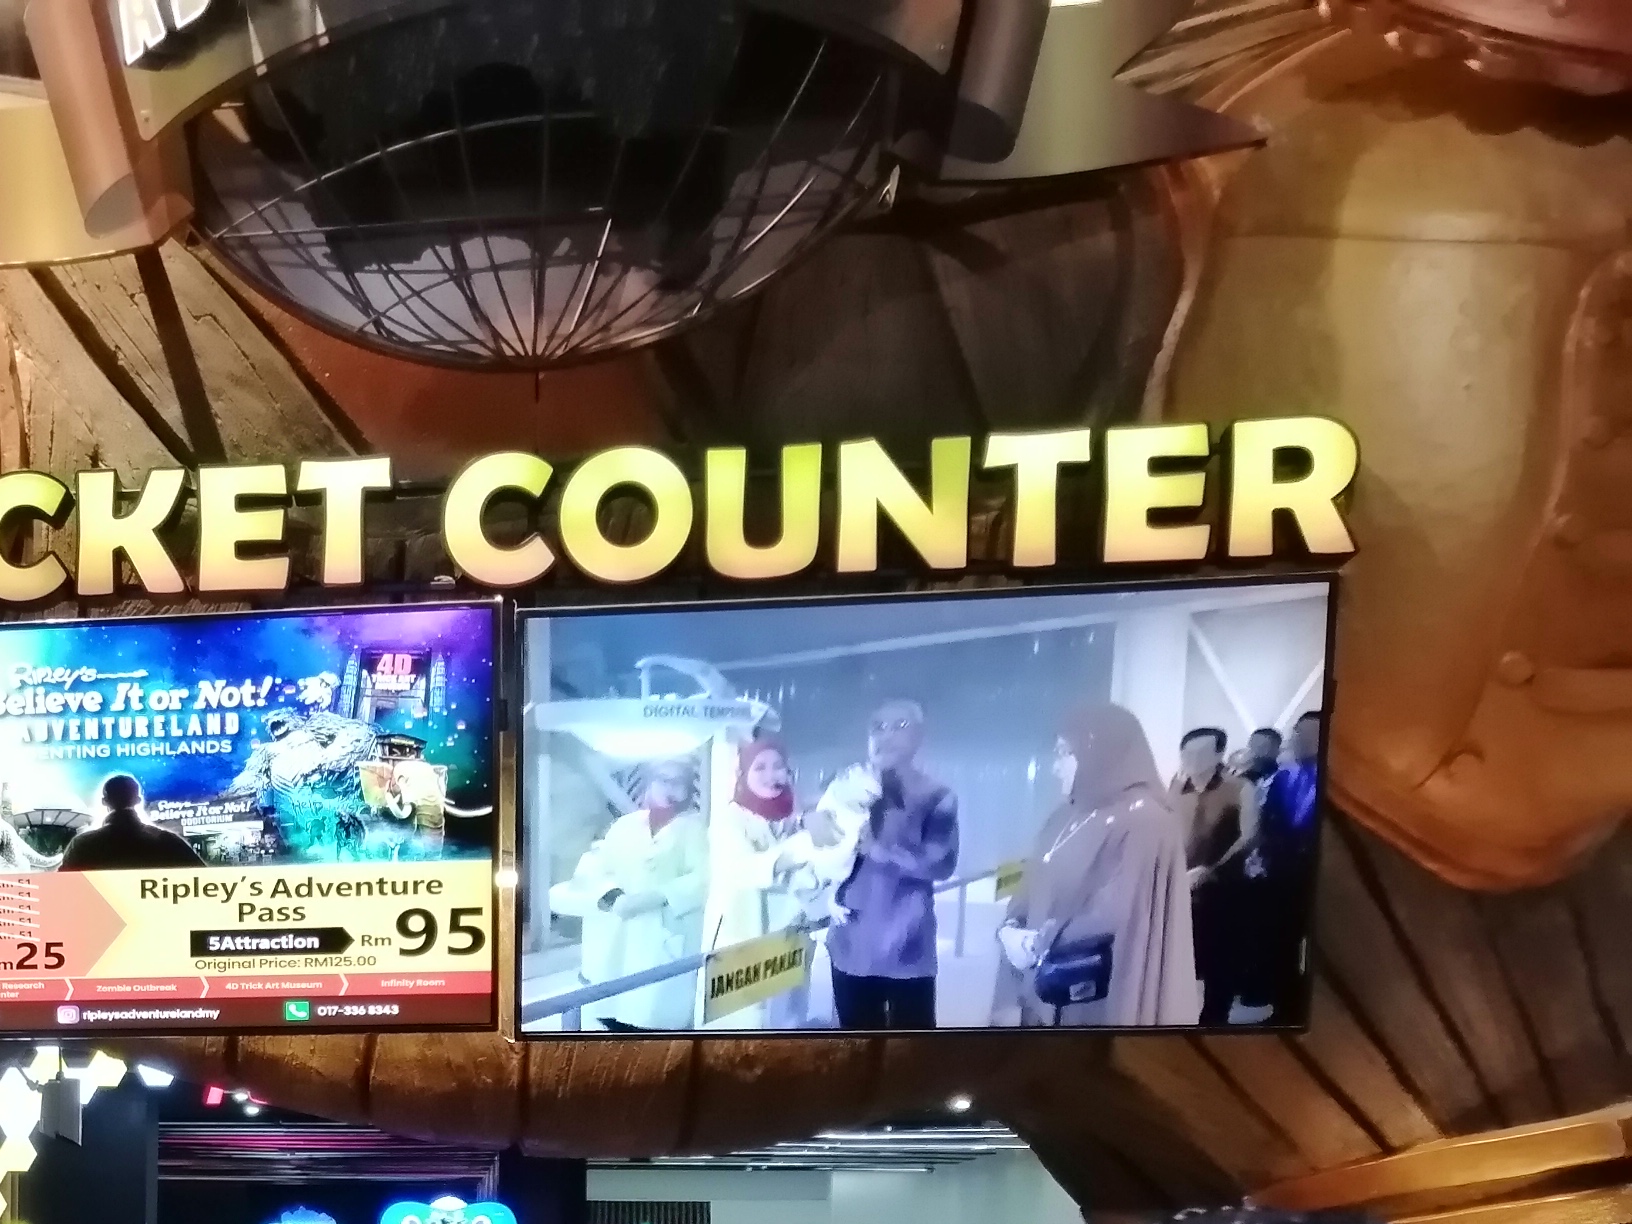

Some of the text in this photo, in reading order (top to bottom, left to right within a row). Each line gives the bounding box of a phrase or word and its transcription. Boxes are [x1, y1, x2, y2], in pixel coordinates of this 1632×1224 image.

[443, 416, 1361, 585] COUNTER
[111, 683, 144, 711] It
[149, 688, 190, 710] or
[194, 676, 273, 709] Not!
[28, 739, 232, 760] ENTING HIGHLANDS
[140, 874, 444, 904] Ripley's Adventure
[238, 902, 306, 923] Pass
[208, 935, 320, 952] 5Attraction
[395, 906, 486, 958] 95
[195, 955, 377, 973] Original Price: RM125.00
[96, 984, 131, 993] Zombie
[225, 980, 323, 990] 4D Trick Art Museum
[381, 978, 414, 988] Infinity
